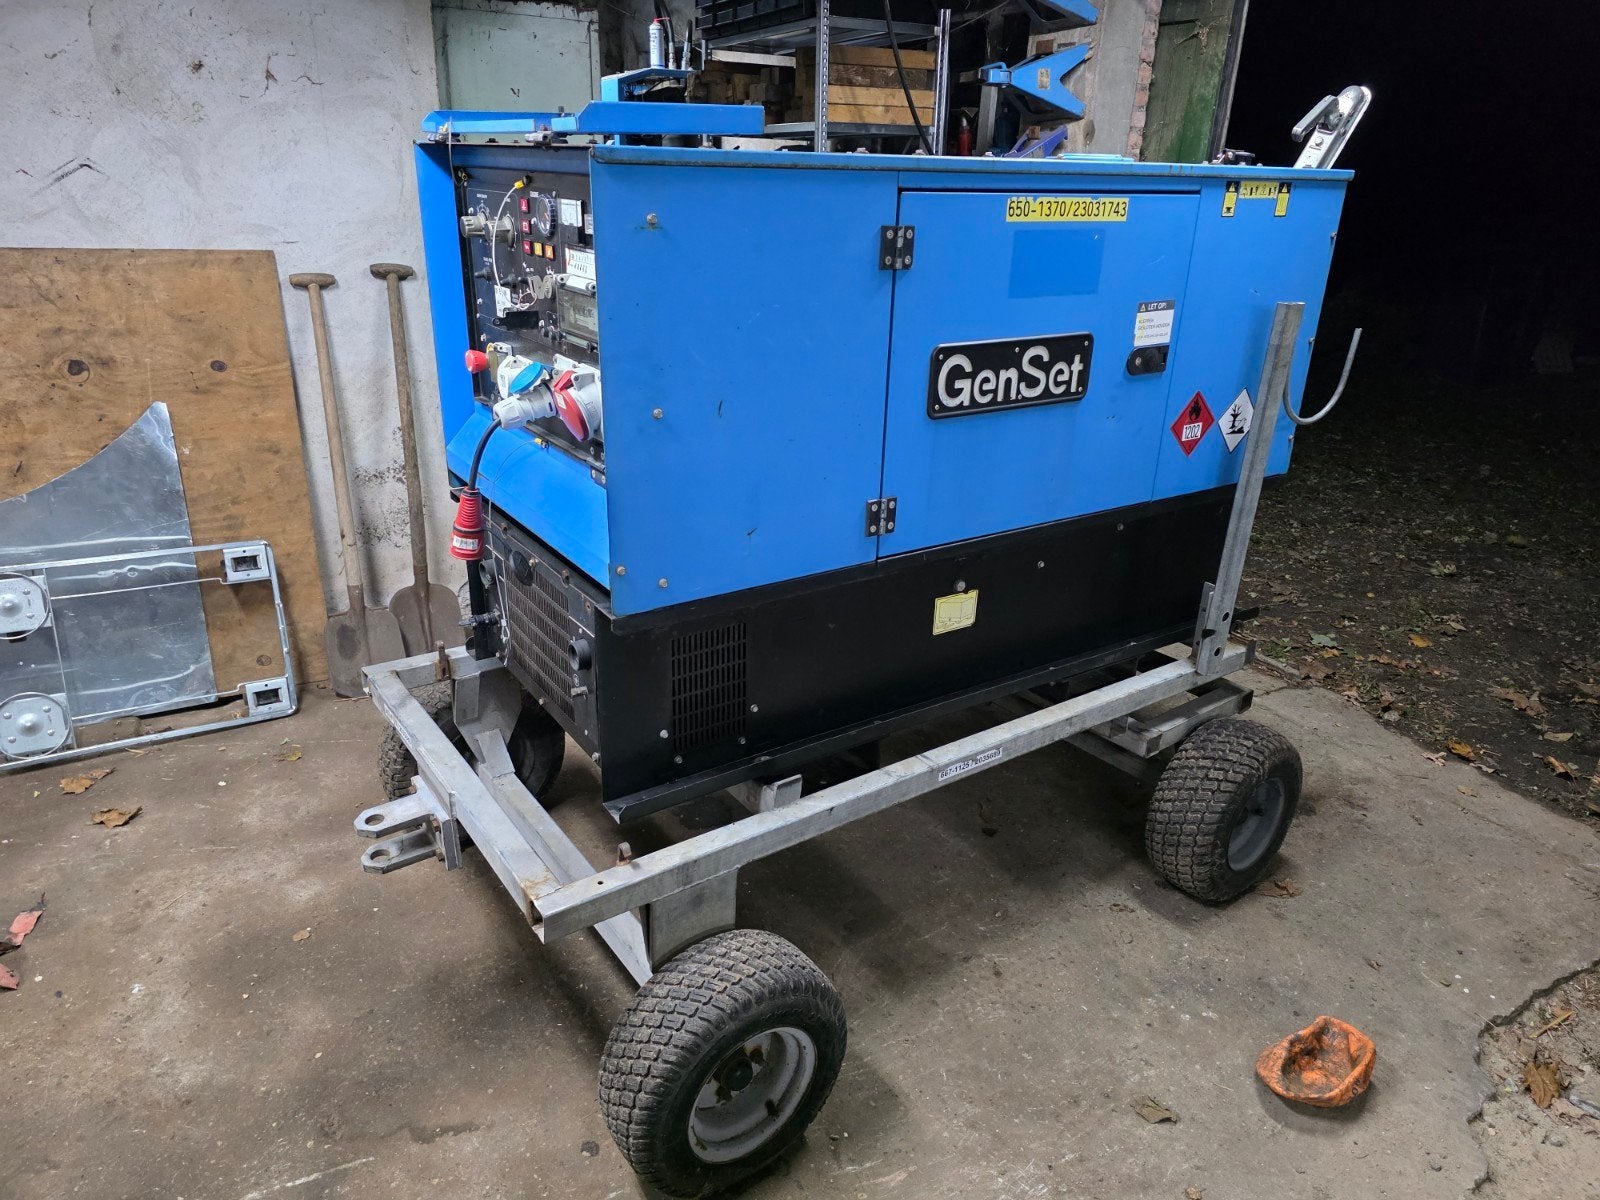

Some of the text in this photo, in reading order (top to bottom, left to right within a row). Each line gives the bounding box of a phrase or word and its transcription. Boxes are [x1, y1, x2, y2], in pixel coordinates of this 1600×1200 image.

[1008, 200, 1127, 218] 650-1370/23031743
[1147, 303, 1157, 311] LET
[938, 345, 1084, 407] GenSet
[1184, 424, 1201, 440] 1202
